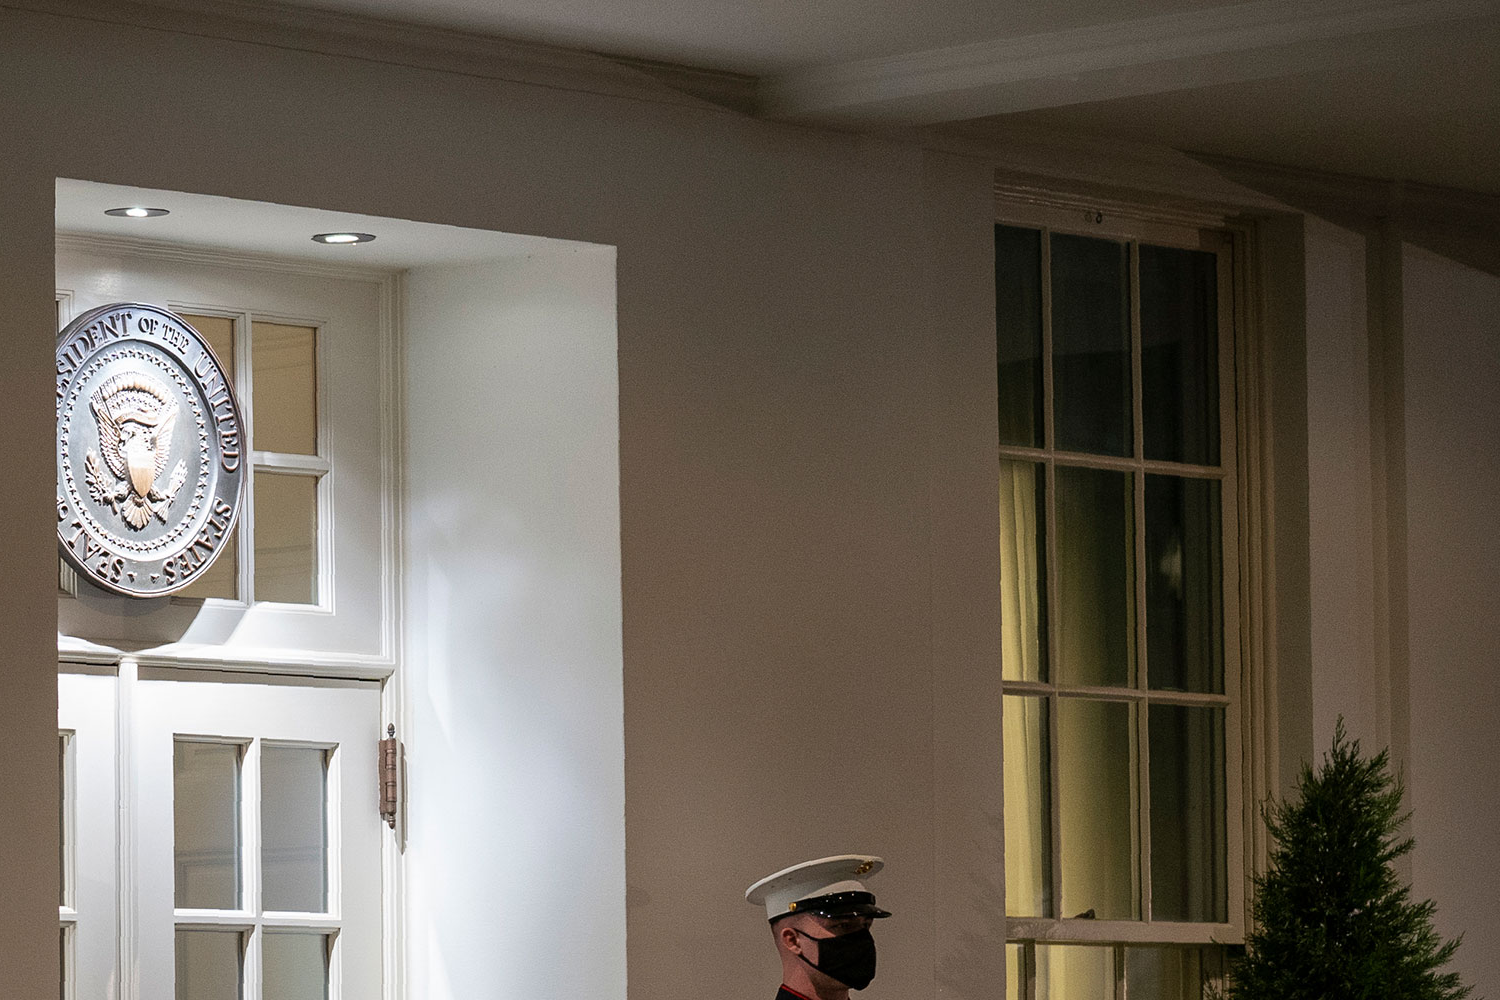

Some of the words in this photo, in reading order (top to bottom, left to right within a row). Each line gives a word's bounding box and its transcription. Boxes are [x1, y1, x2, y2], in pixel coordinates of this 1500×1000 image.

[138, 316, 159, 336] OF
[162, 323, 189, 355] THE
[194, 352, 240, 473] UNITED
[67, 520, 125, 584] SEAL
[162, 496, 232, 586] STATES
